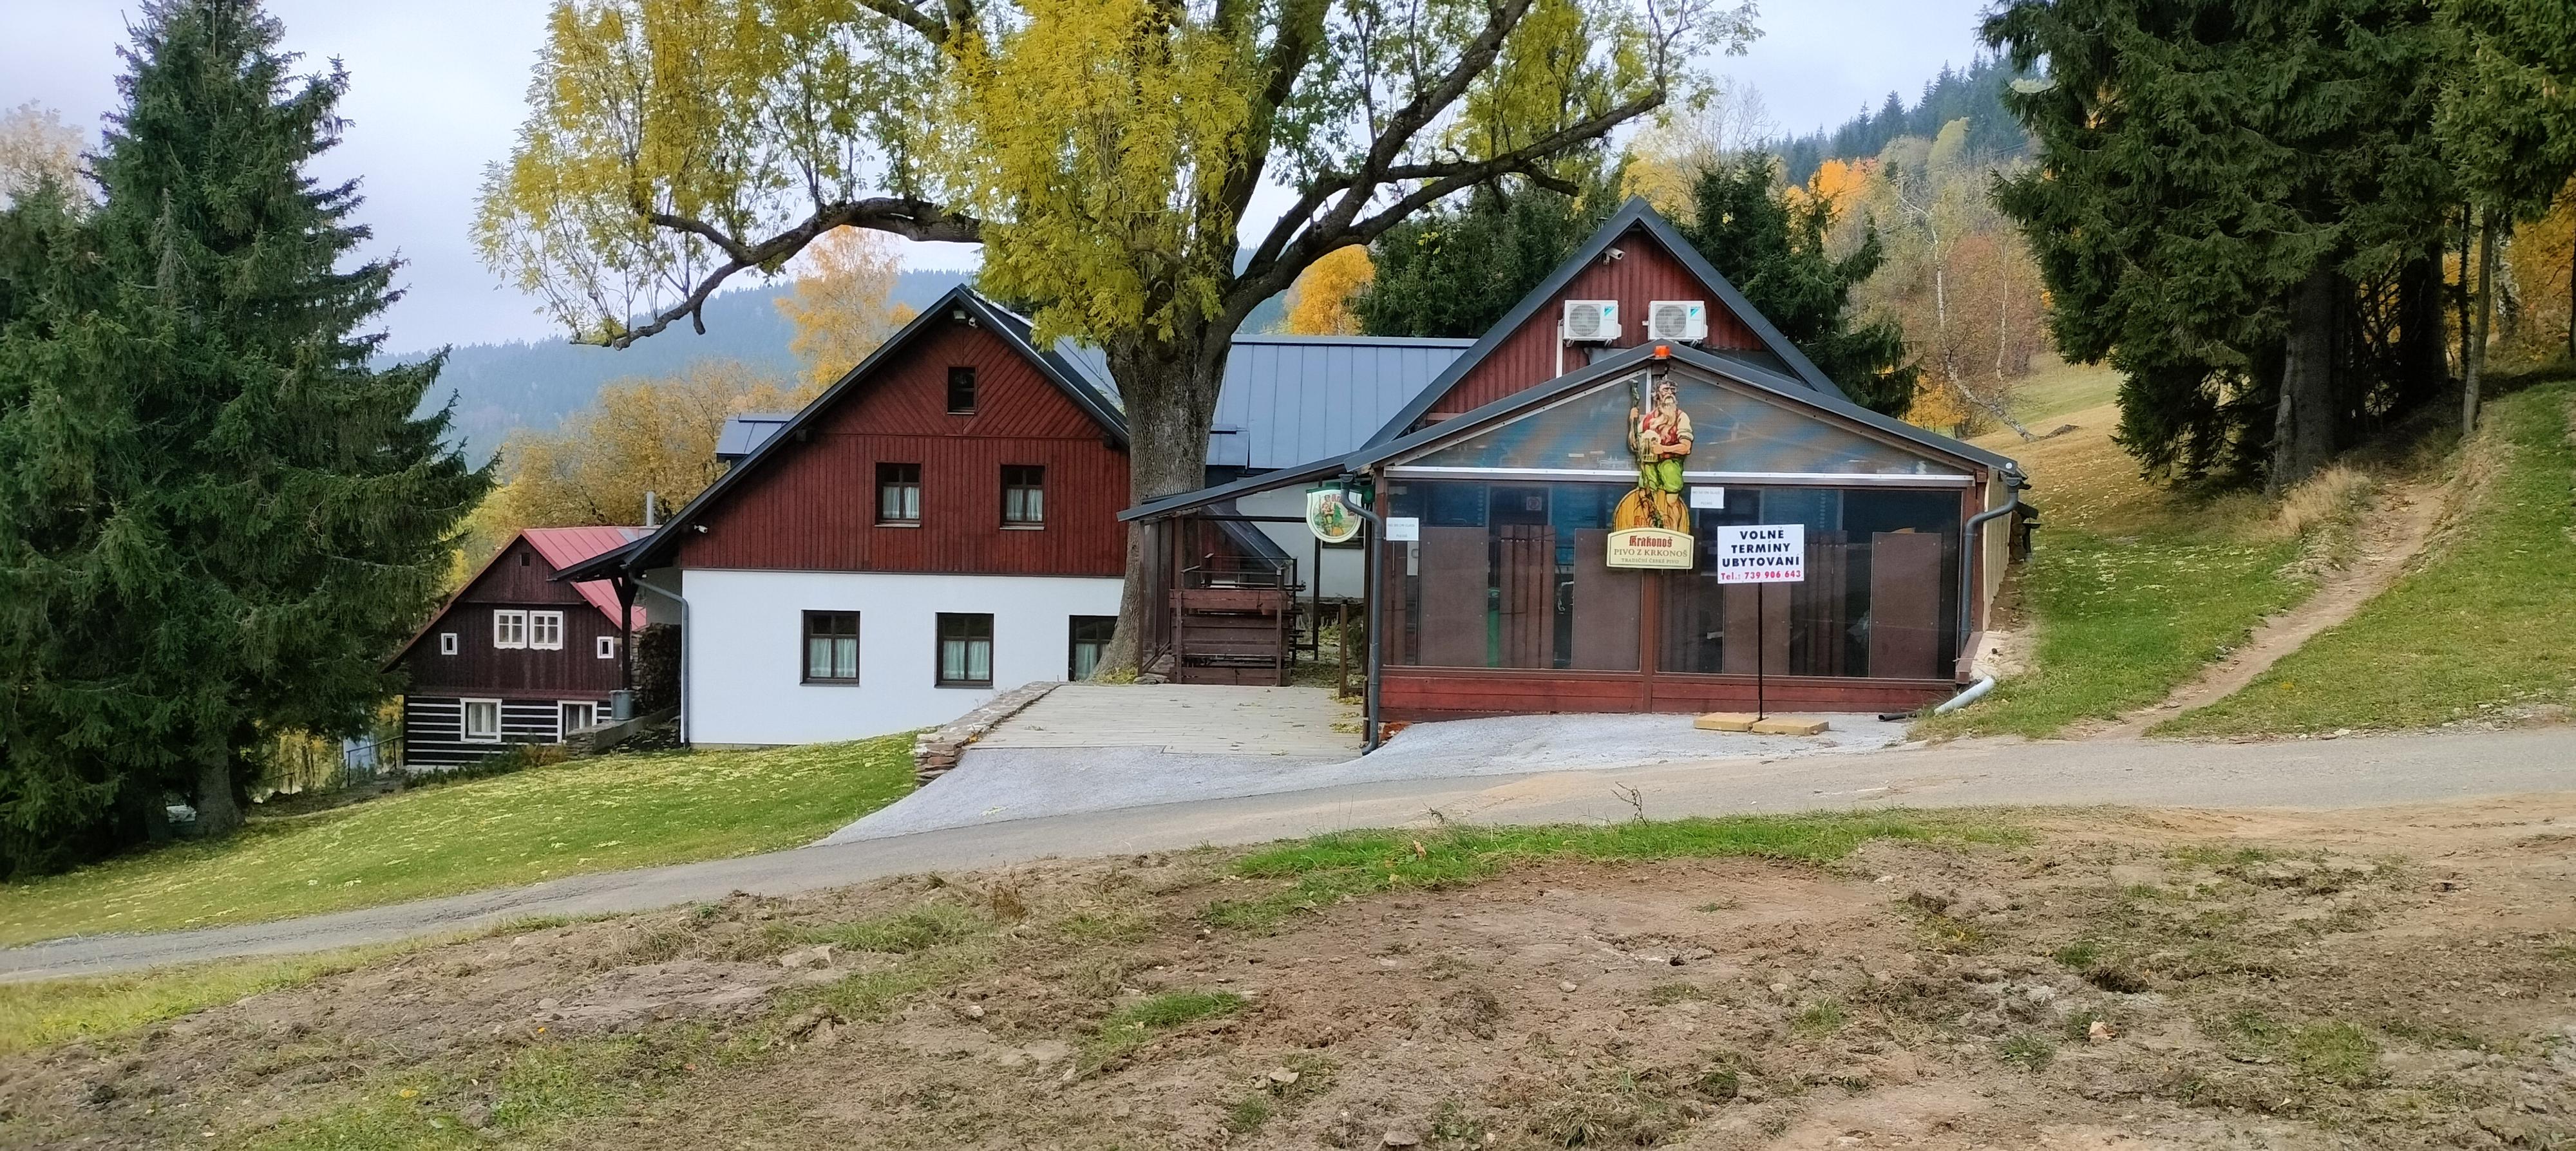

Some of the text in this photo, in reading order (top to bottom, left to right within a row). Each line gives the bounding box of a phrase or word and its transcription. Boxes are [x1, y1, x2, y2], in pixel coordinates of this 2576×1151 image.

[1629, 536, 1673, 548] Krakonoš
[1731, 541, 1791, 554] TERMÍNY
[1644, 548, 1687, 557] KRKONOŠ
[1722, 554, 1799, 567] UBYTOVÁNÍ
[1721, 572, 1741, 580] Tel.:
[1745, 571, 1761, 579] 739
